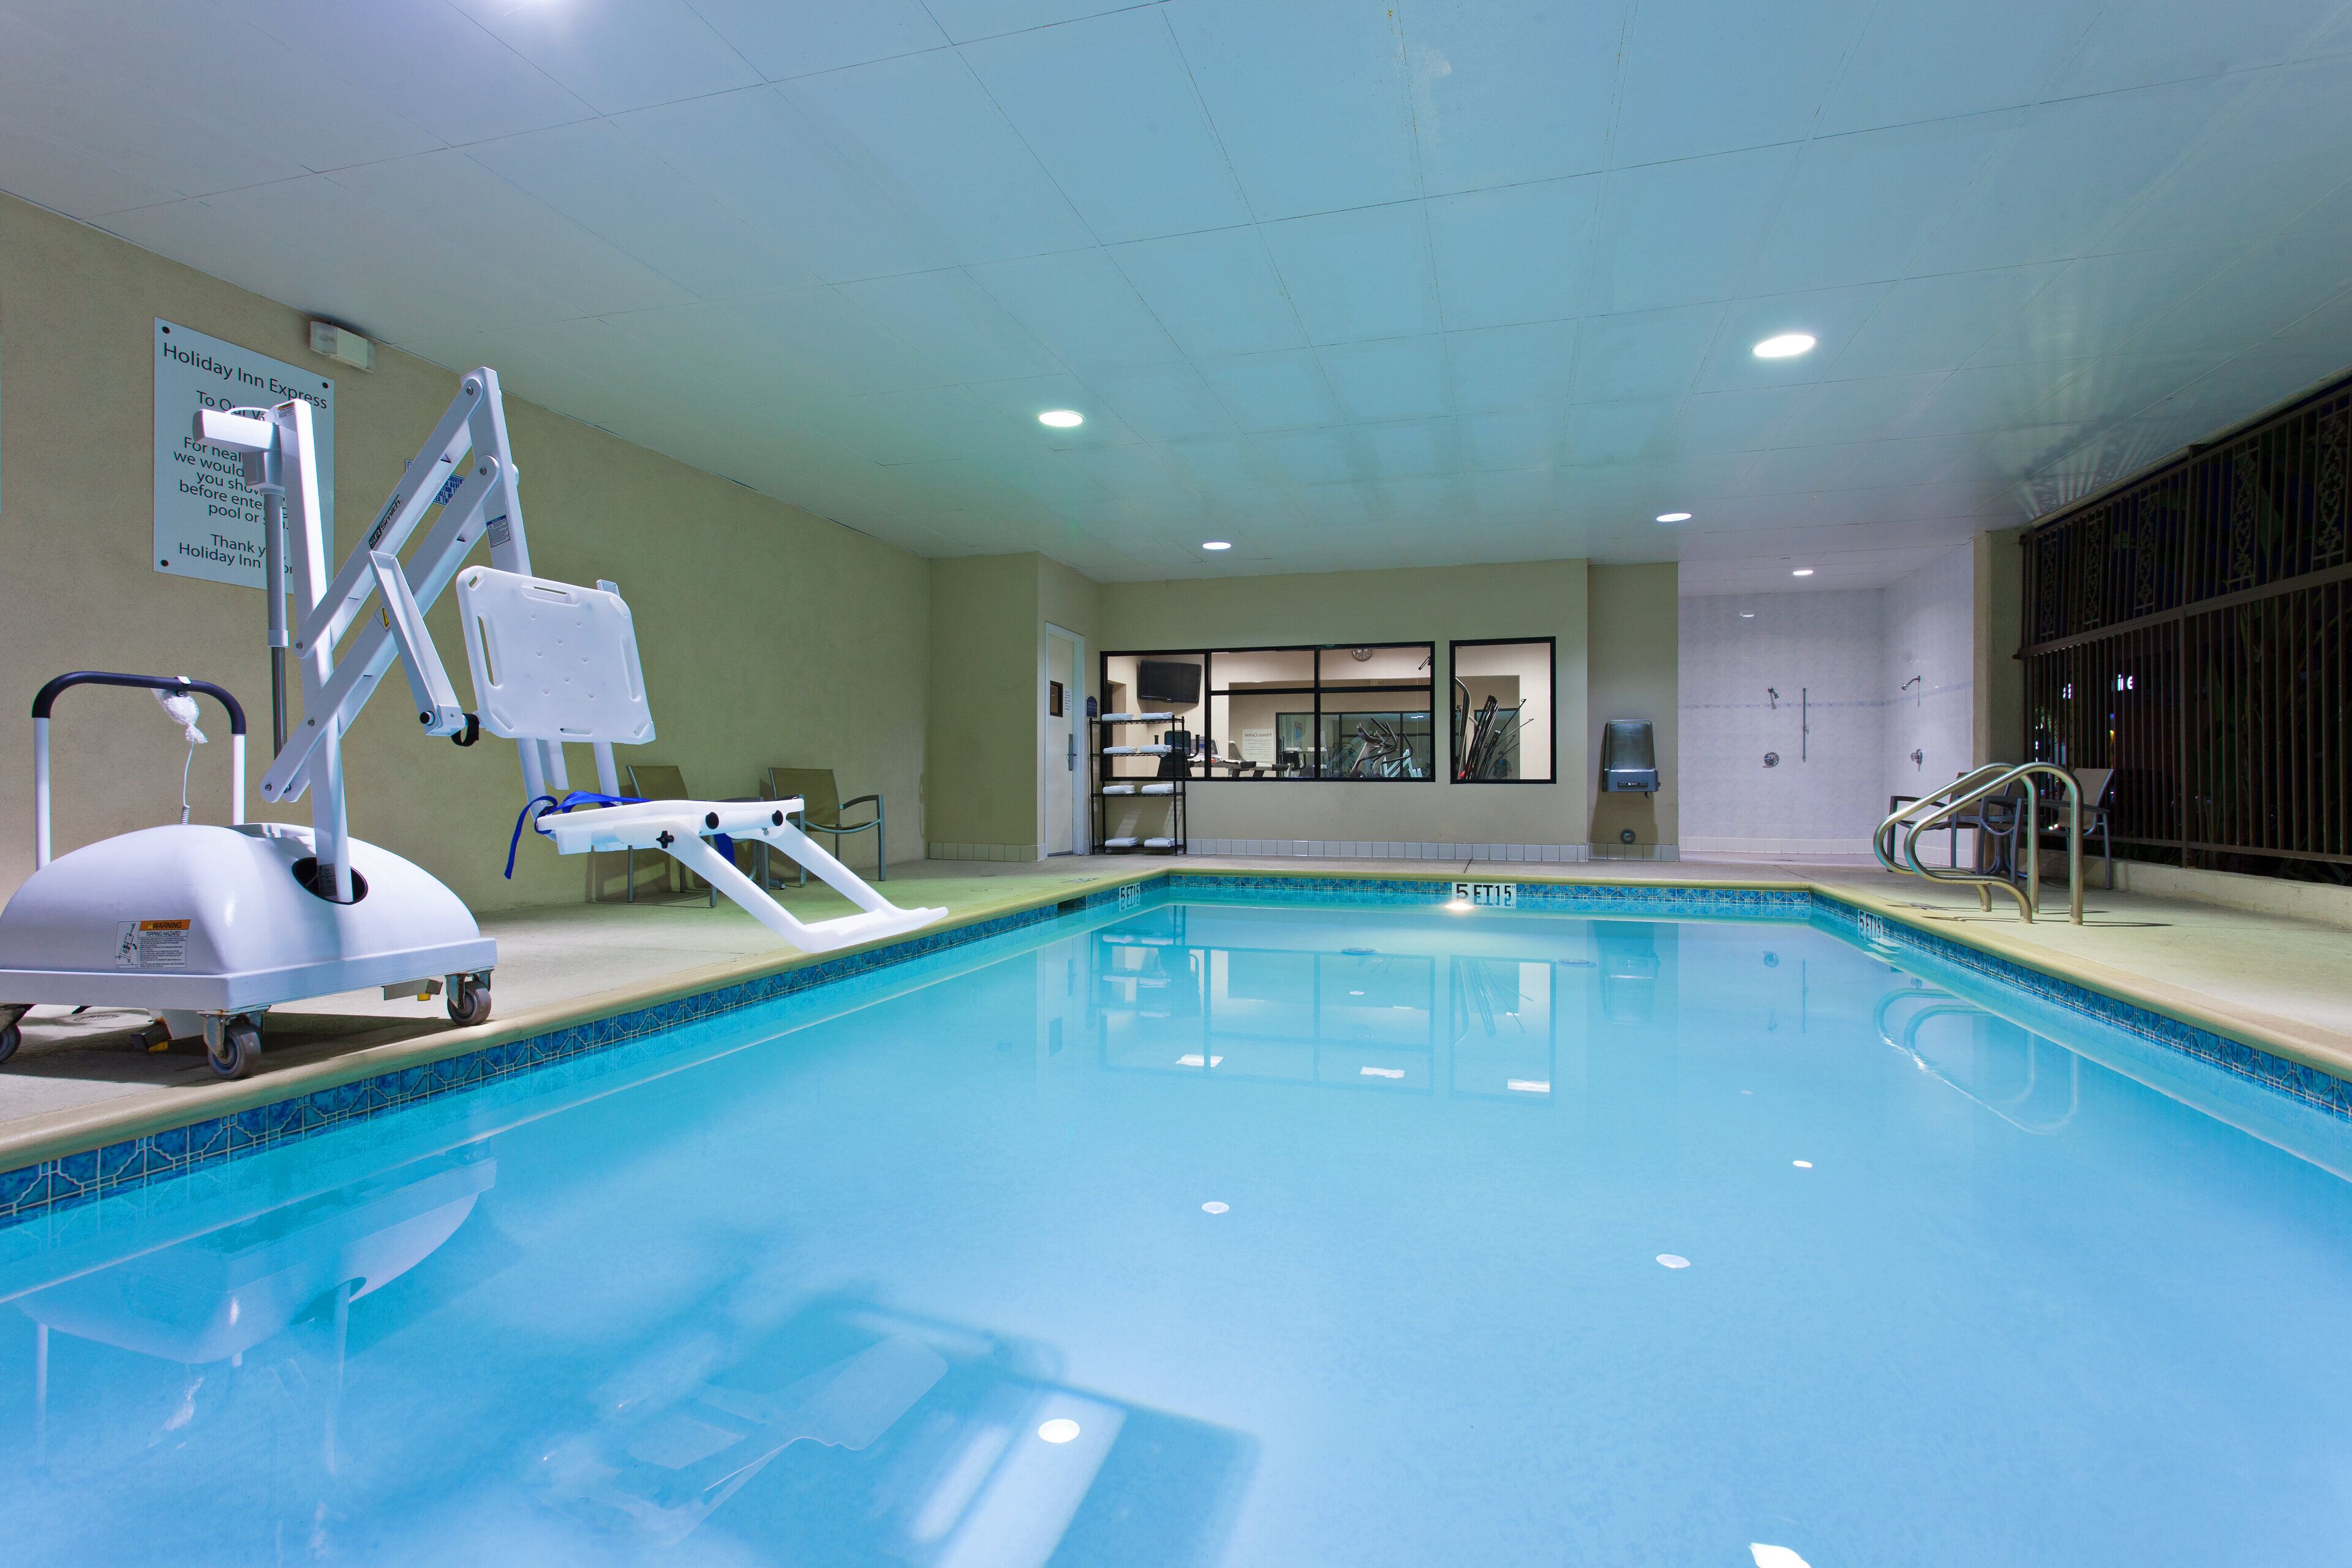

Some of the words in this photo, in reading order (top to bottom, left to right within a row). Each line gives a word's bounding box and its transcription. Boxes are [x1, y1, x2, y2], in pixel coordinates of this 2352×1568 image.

[164, 342, 233, 380] Holiday
[238, 368, 264, 388] Inn
[270, 378, 328, 409] Express
[196, 390, 215, 407] To
[184, 437, 207, 453] For
[173, 451, 196, 465] we
[200, 458, 245, 478] would
[197, 472, 223, 486] you
[179, 480, 227, 502] before
[209, 504, 240, 519] pool
[245, 513, 259, 522] or
[211, 533, 255, 553] Thank
[179, 542, 235, 566] Holiday
[239, 554, 261, 568] Inn
[1456, 883, 1469, 896] 5
